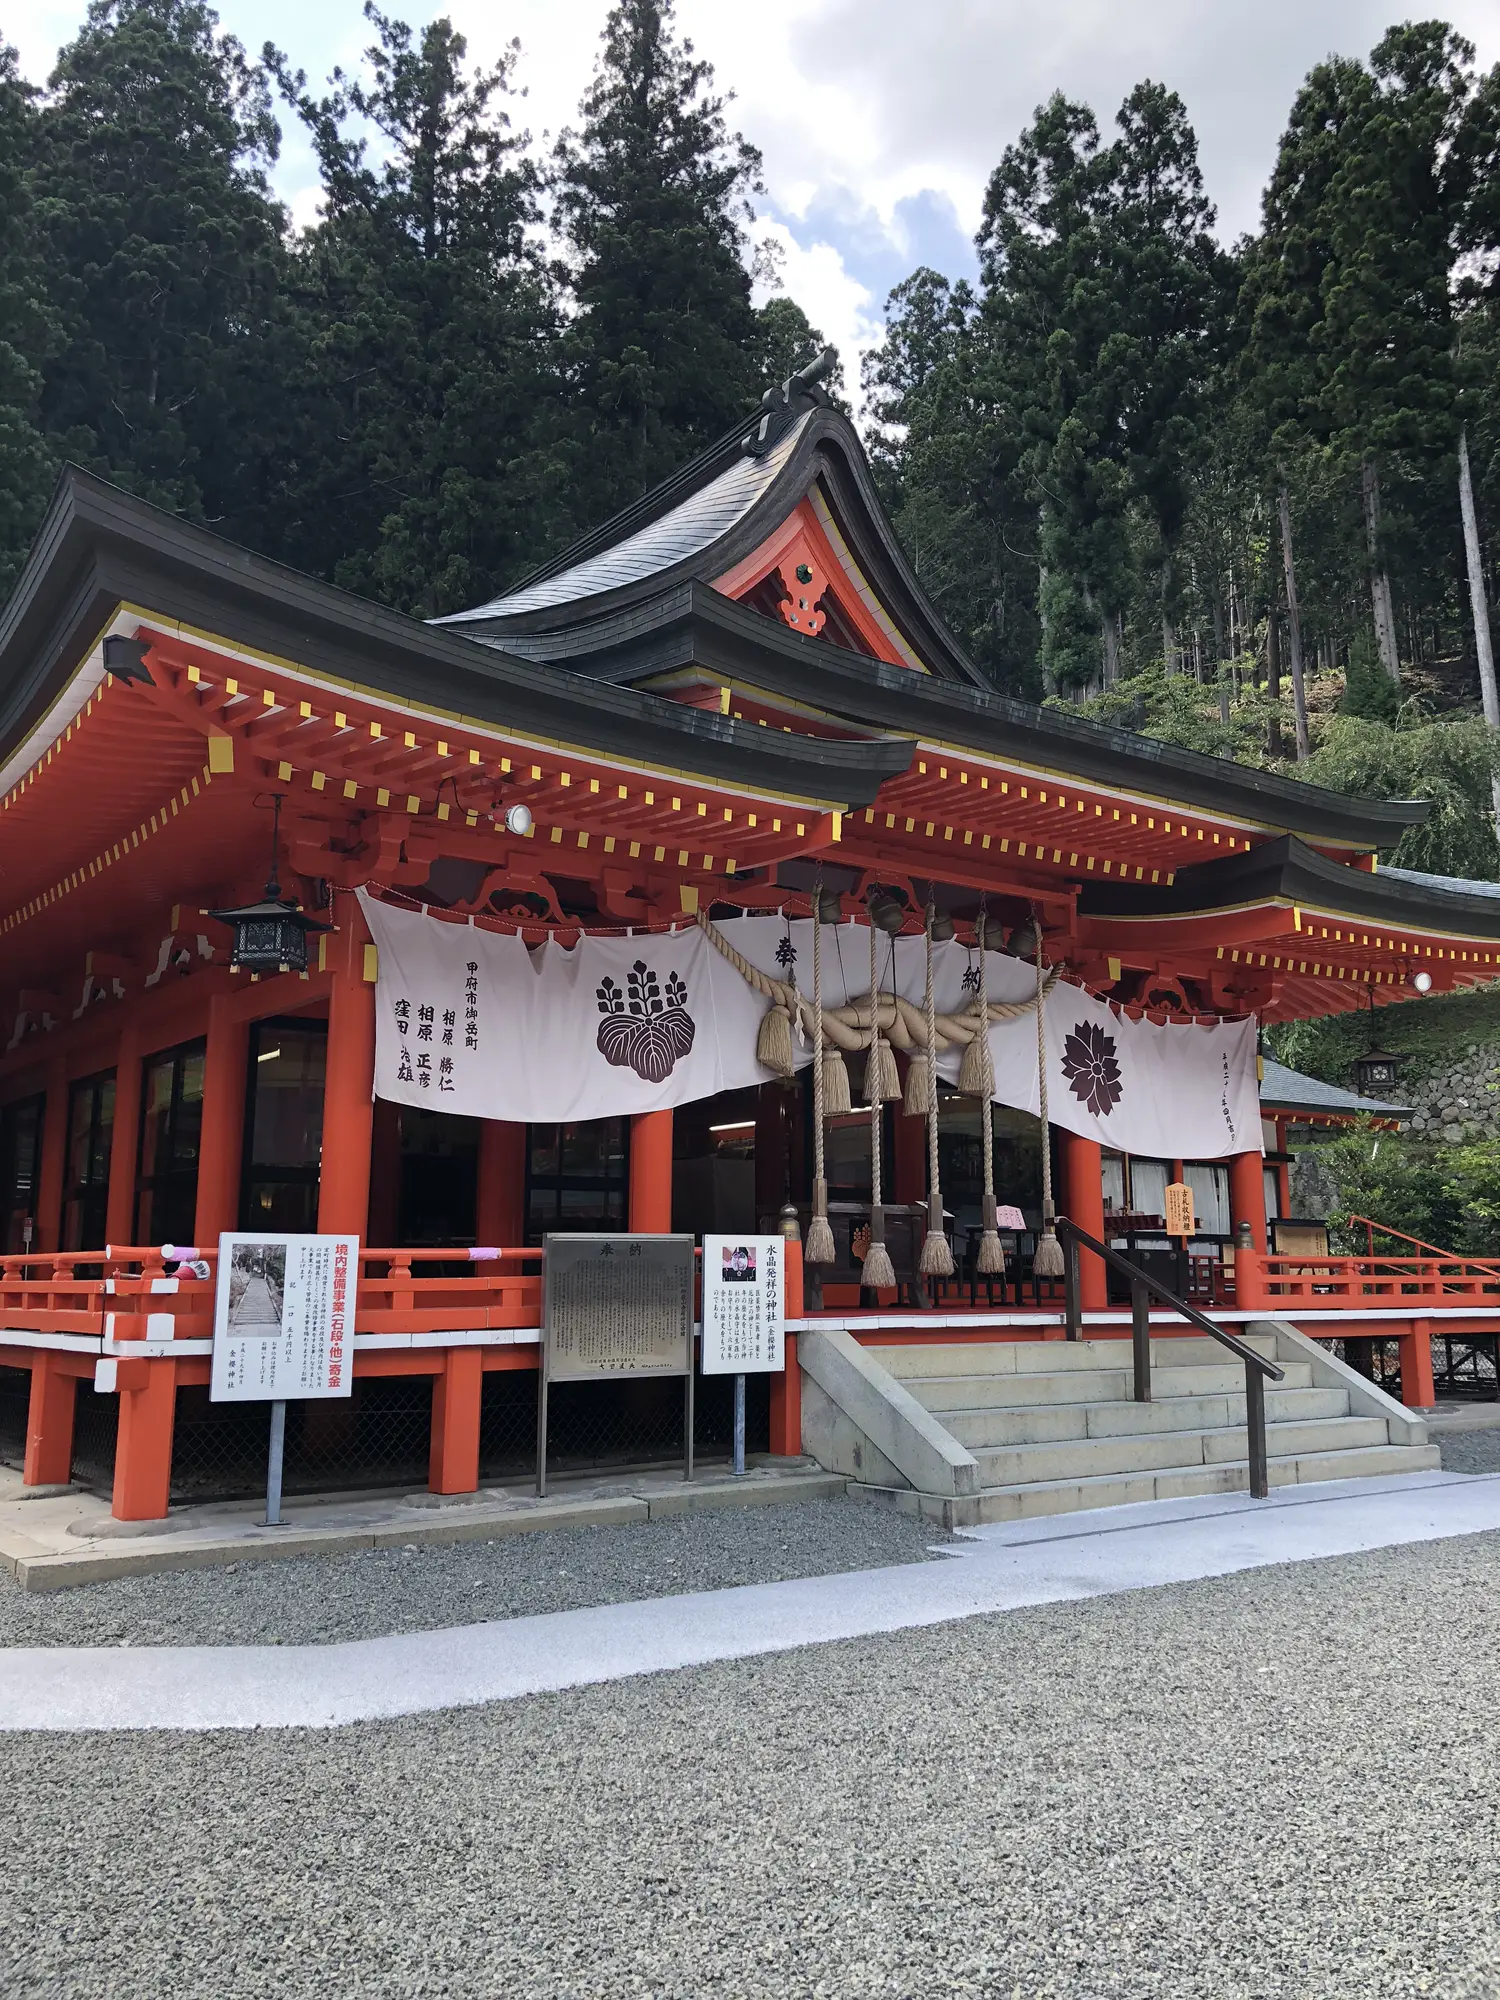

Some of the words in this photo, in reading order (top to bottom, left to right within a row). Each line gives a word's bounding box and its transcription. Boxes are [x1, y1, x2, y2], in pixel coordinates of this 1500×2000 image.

[775, 936, 797, 968] 奉
[961, 965, 981, 993] 納
[394, 998, 411, 1035] 窪田
[417, 1003, 435, 1042] 相原
[465, 961, 478, 1051] 甲府市御岳町
[442, 1008, 456, 1046] 相原
[416, 1053, 432, 1088] 正彦
[438, 1056, 455, 1092] 勝仁
[289, 1281, 297, 1289] 記
